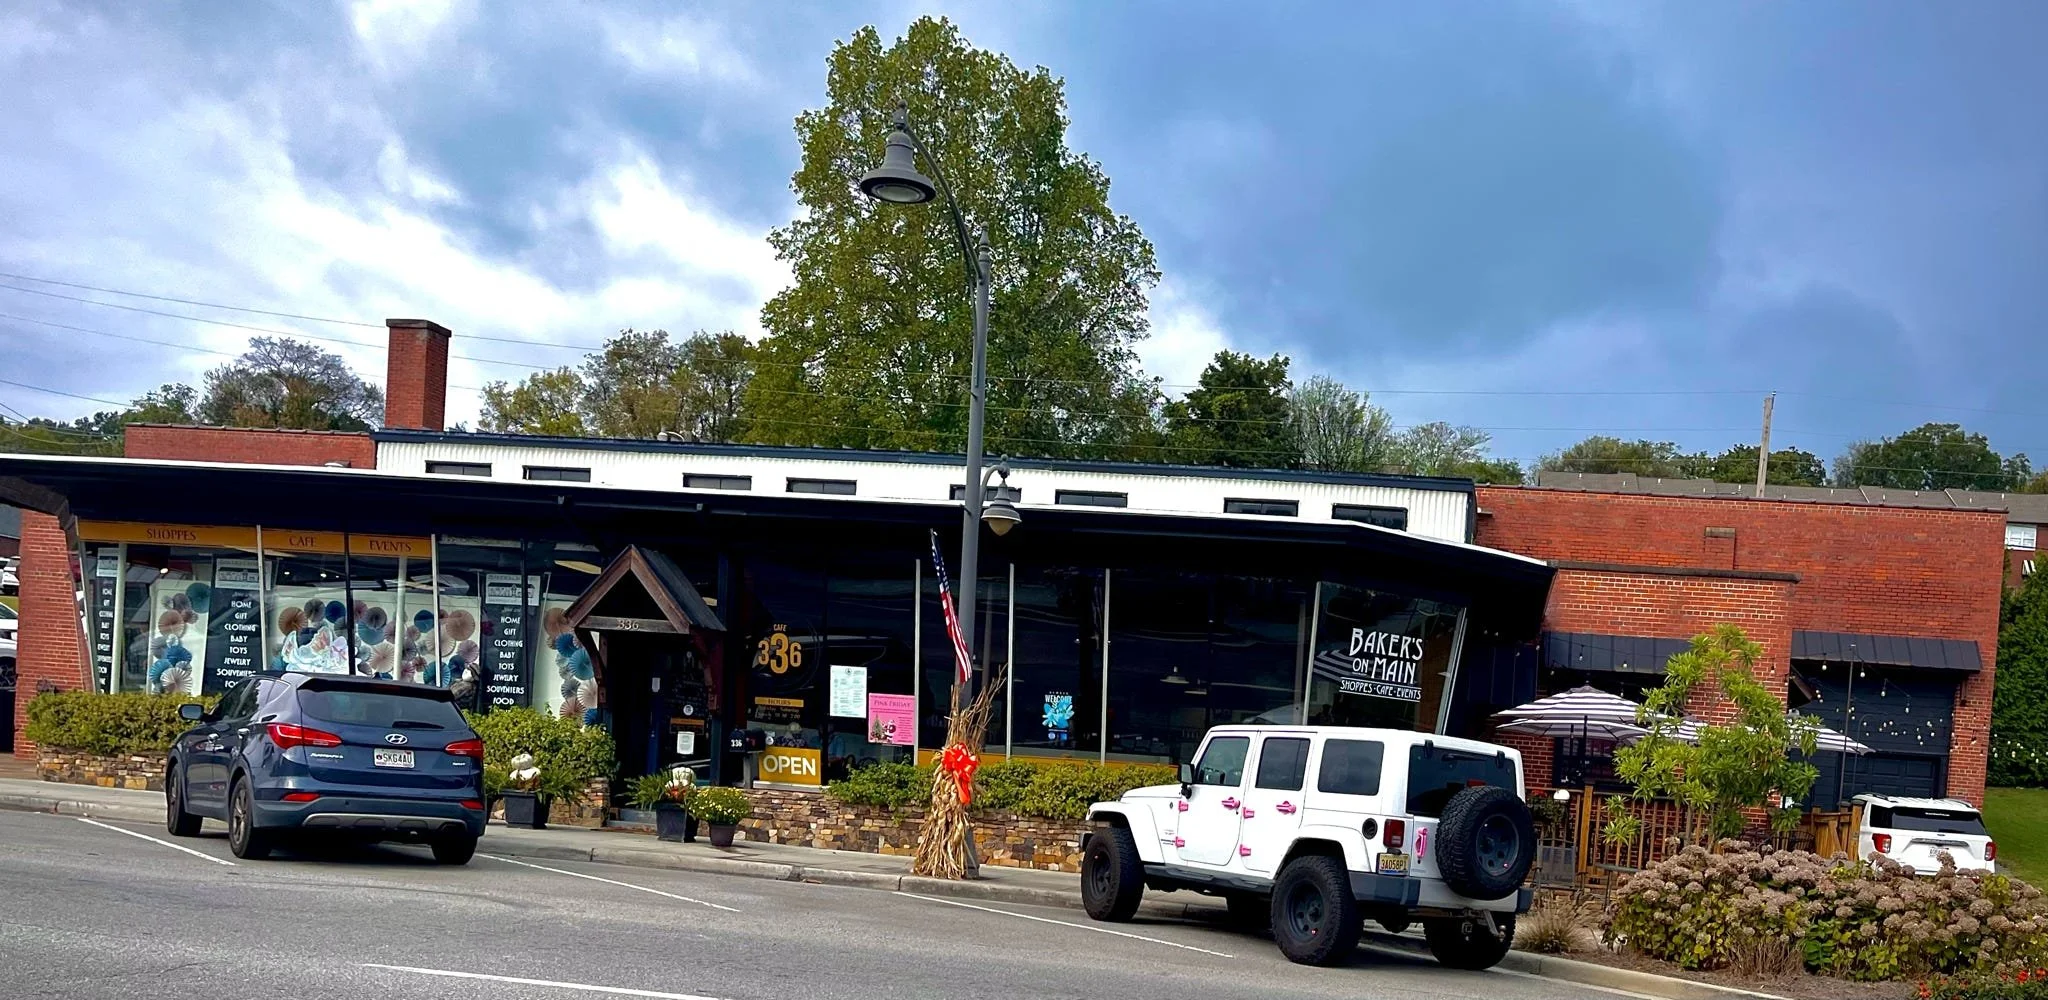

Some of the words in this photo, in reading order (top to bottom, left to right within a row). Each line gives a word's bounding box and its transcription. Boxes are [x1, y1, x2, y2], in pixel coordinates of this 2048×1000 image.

[146, 528, 196, 541] SHOPPES
[289, 536, 316, 548] CAFE
[369, 539, 412, 552] EVENTS
[231, 600, 252, 609] HOME
[234, 612, 247, 620] GIFT
[500, 616, 521, 625] HOME
[224, 623, 256, 632] CLOTHING
[617, 619, 639, 630] 336
[773, 623, 787, 631] CAFE
[503, 628, 517, 636] GIFT
[230, 635, 248, 643] BABY
[494, 639, 523, 648] CLOTHING
[1349, 627, 1423, 660] BAKER'S
[229, 646, 248, 654] TOYS
[758, 632, 802, 674] 336
[499, 651, 515, 659] BABY
[223, 657, 251, 666] JEWELRY
[498, 662, 515, 670] TOYS
[1352, 657, 1369, 673] ON
[1371, 657, 1416, 684] MAIN
[493, 673, 519, 682] JEWELRY
[1340, 679, 1373, 694] SHOPPES
[1376, 684, 1393, 696] CAFE
[1396, 687, 1421, 700] EVENTS
[492, 697, 515, 706] FOOD
[1044, 694, 1073, 704] WELCOME
[763, 754, 816, 777] OPEN
